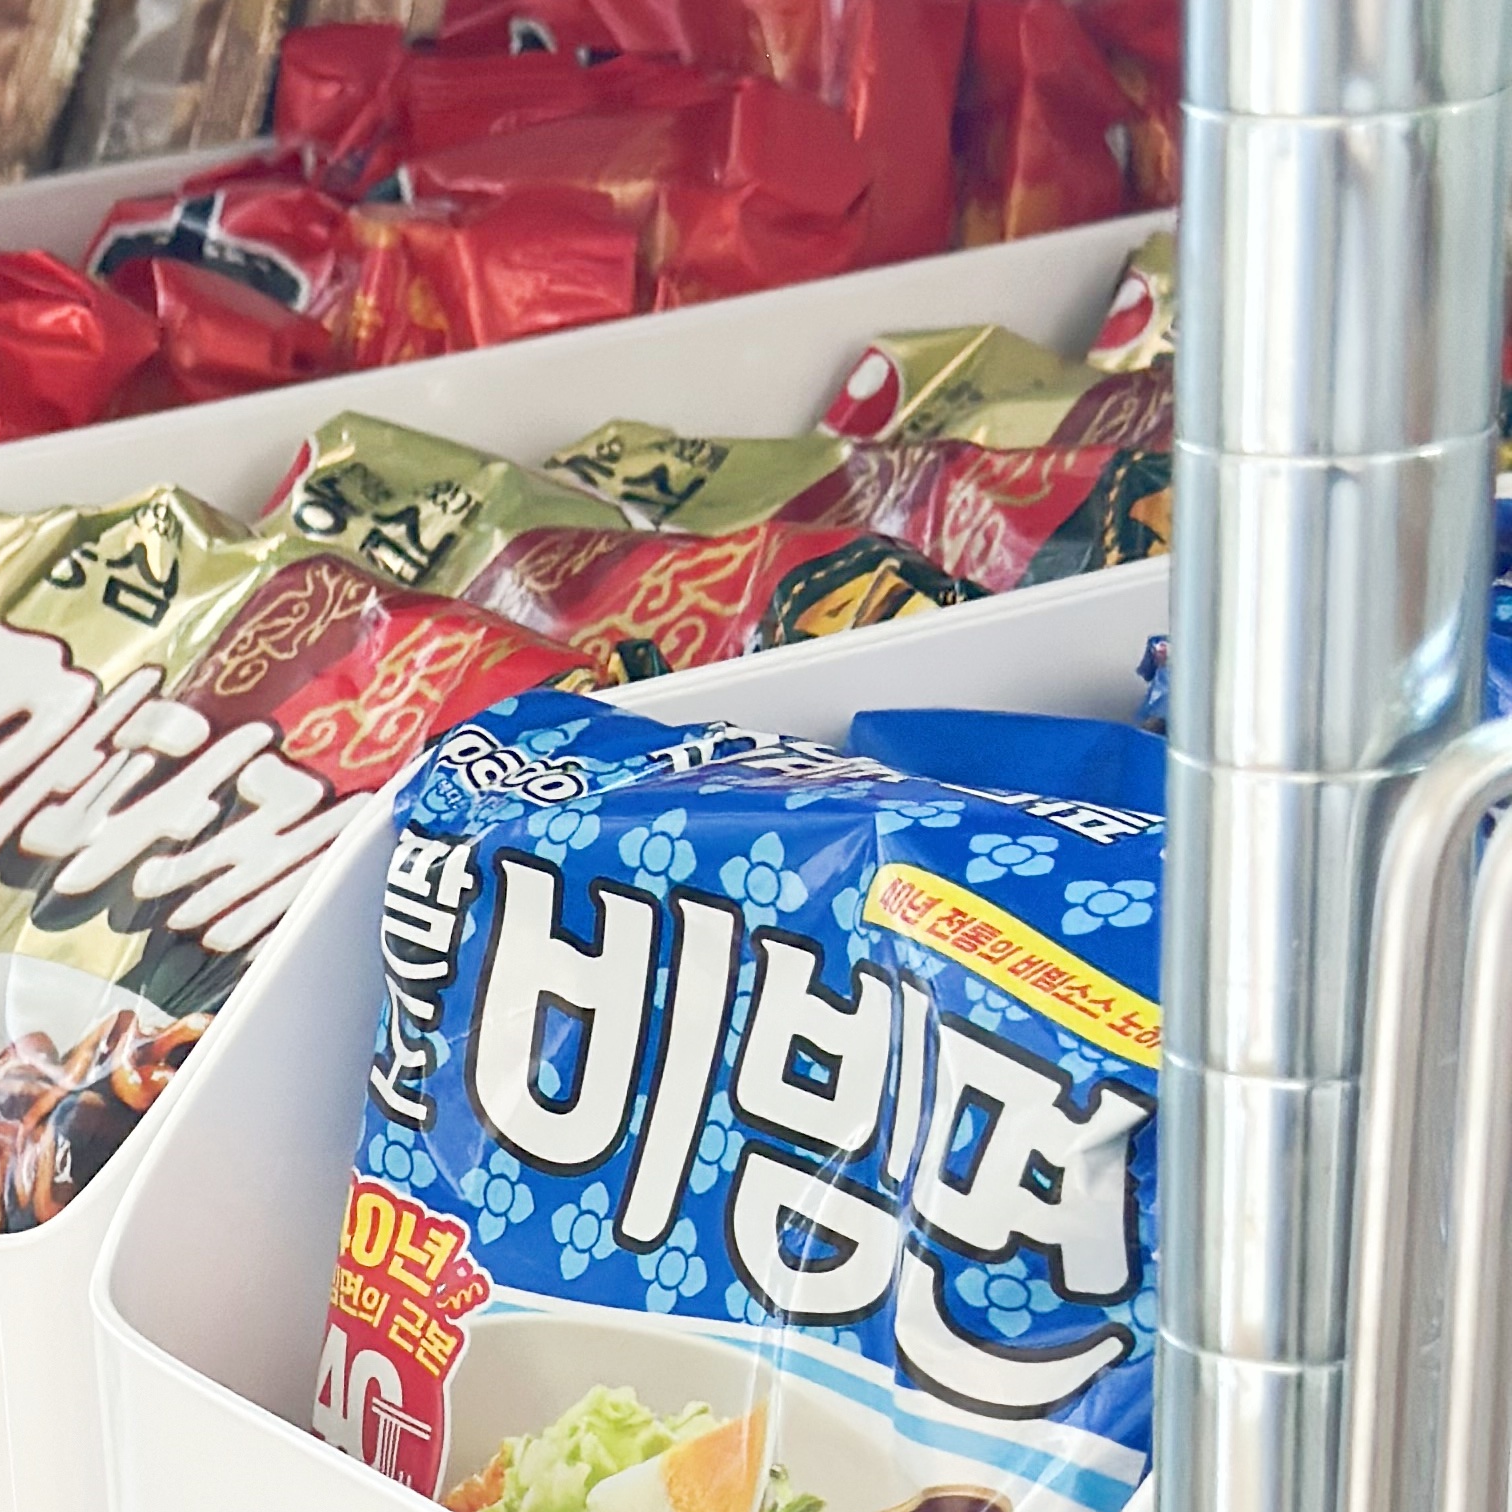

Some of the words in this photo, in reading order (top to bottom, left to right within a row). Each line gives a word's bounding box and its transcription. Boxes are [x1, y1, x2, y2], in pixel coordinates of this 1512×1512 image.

[879, 877, 943, 925] 40년
[926, 906, 1023, 966] 전통의
[1006, 953, 1115, 1020] 비빔소스
[468, 852, 1154, 1416] 비빔면
[339, 1184, 457, 1297] 0년
[387, 1298, 458, 1377] 근본
